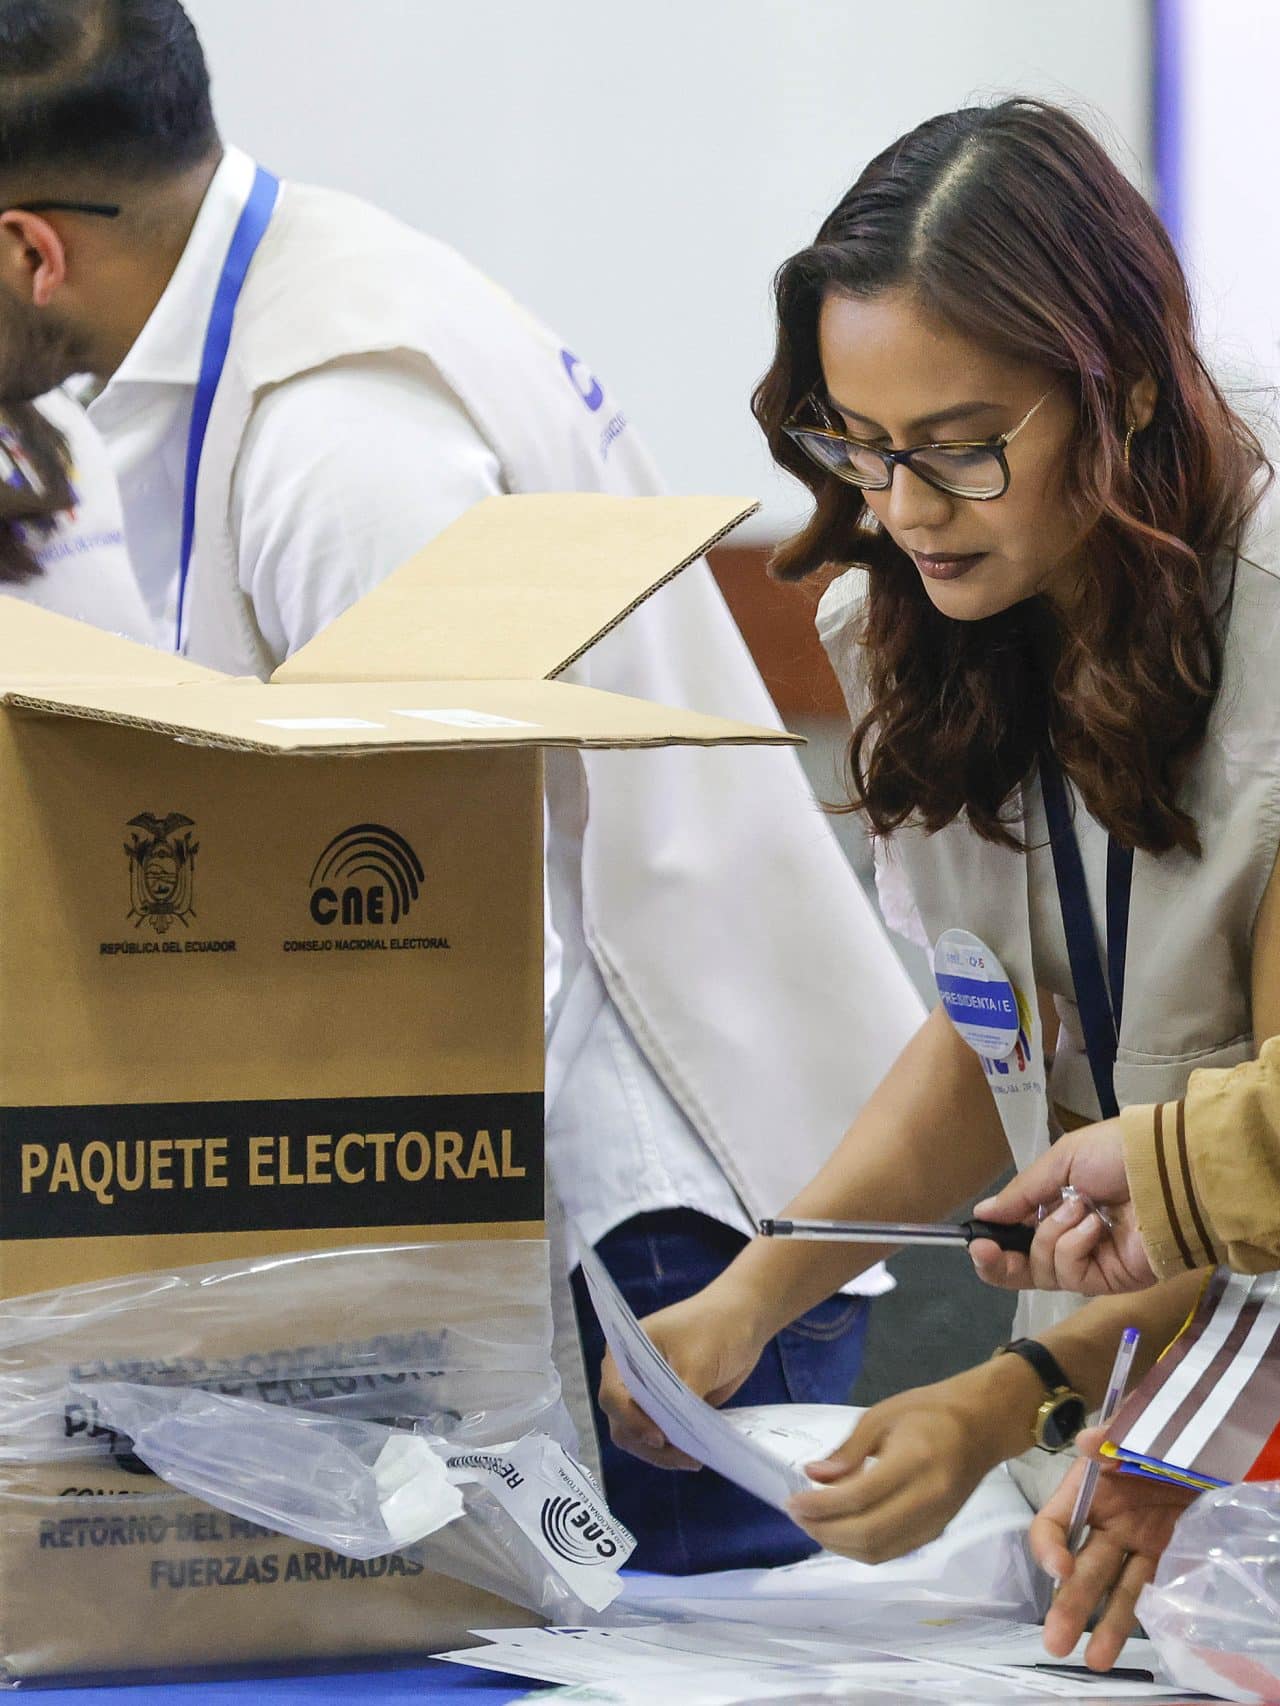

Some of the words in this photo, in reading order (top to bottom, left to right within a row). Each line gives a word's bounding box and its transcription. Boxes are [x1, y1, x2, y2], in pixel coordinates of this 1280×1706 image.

[100, 939, 159, 954] REPÚBLICA
[162, 940, 182, 953] DEL
[185, 939, 237, 953] ECUADOR
[283, 940, 332, 952] CONSEJO
[335, 939, 388, 951] NACIONAL
[390, 938, 451, 950] ELECTORAL
[20, 1138, 229, 1204] PAQUETE
[248, 1129, 526, 1187] ELECTORAL
[40, 1515, 168, 1549] RETORNO
[175, 1513, 223, 1542] DEL
[150, 1553, 279, 1589] FUERZAS
[283, 1550, 425, 1583] ARMADAS
